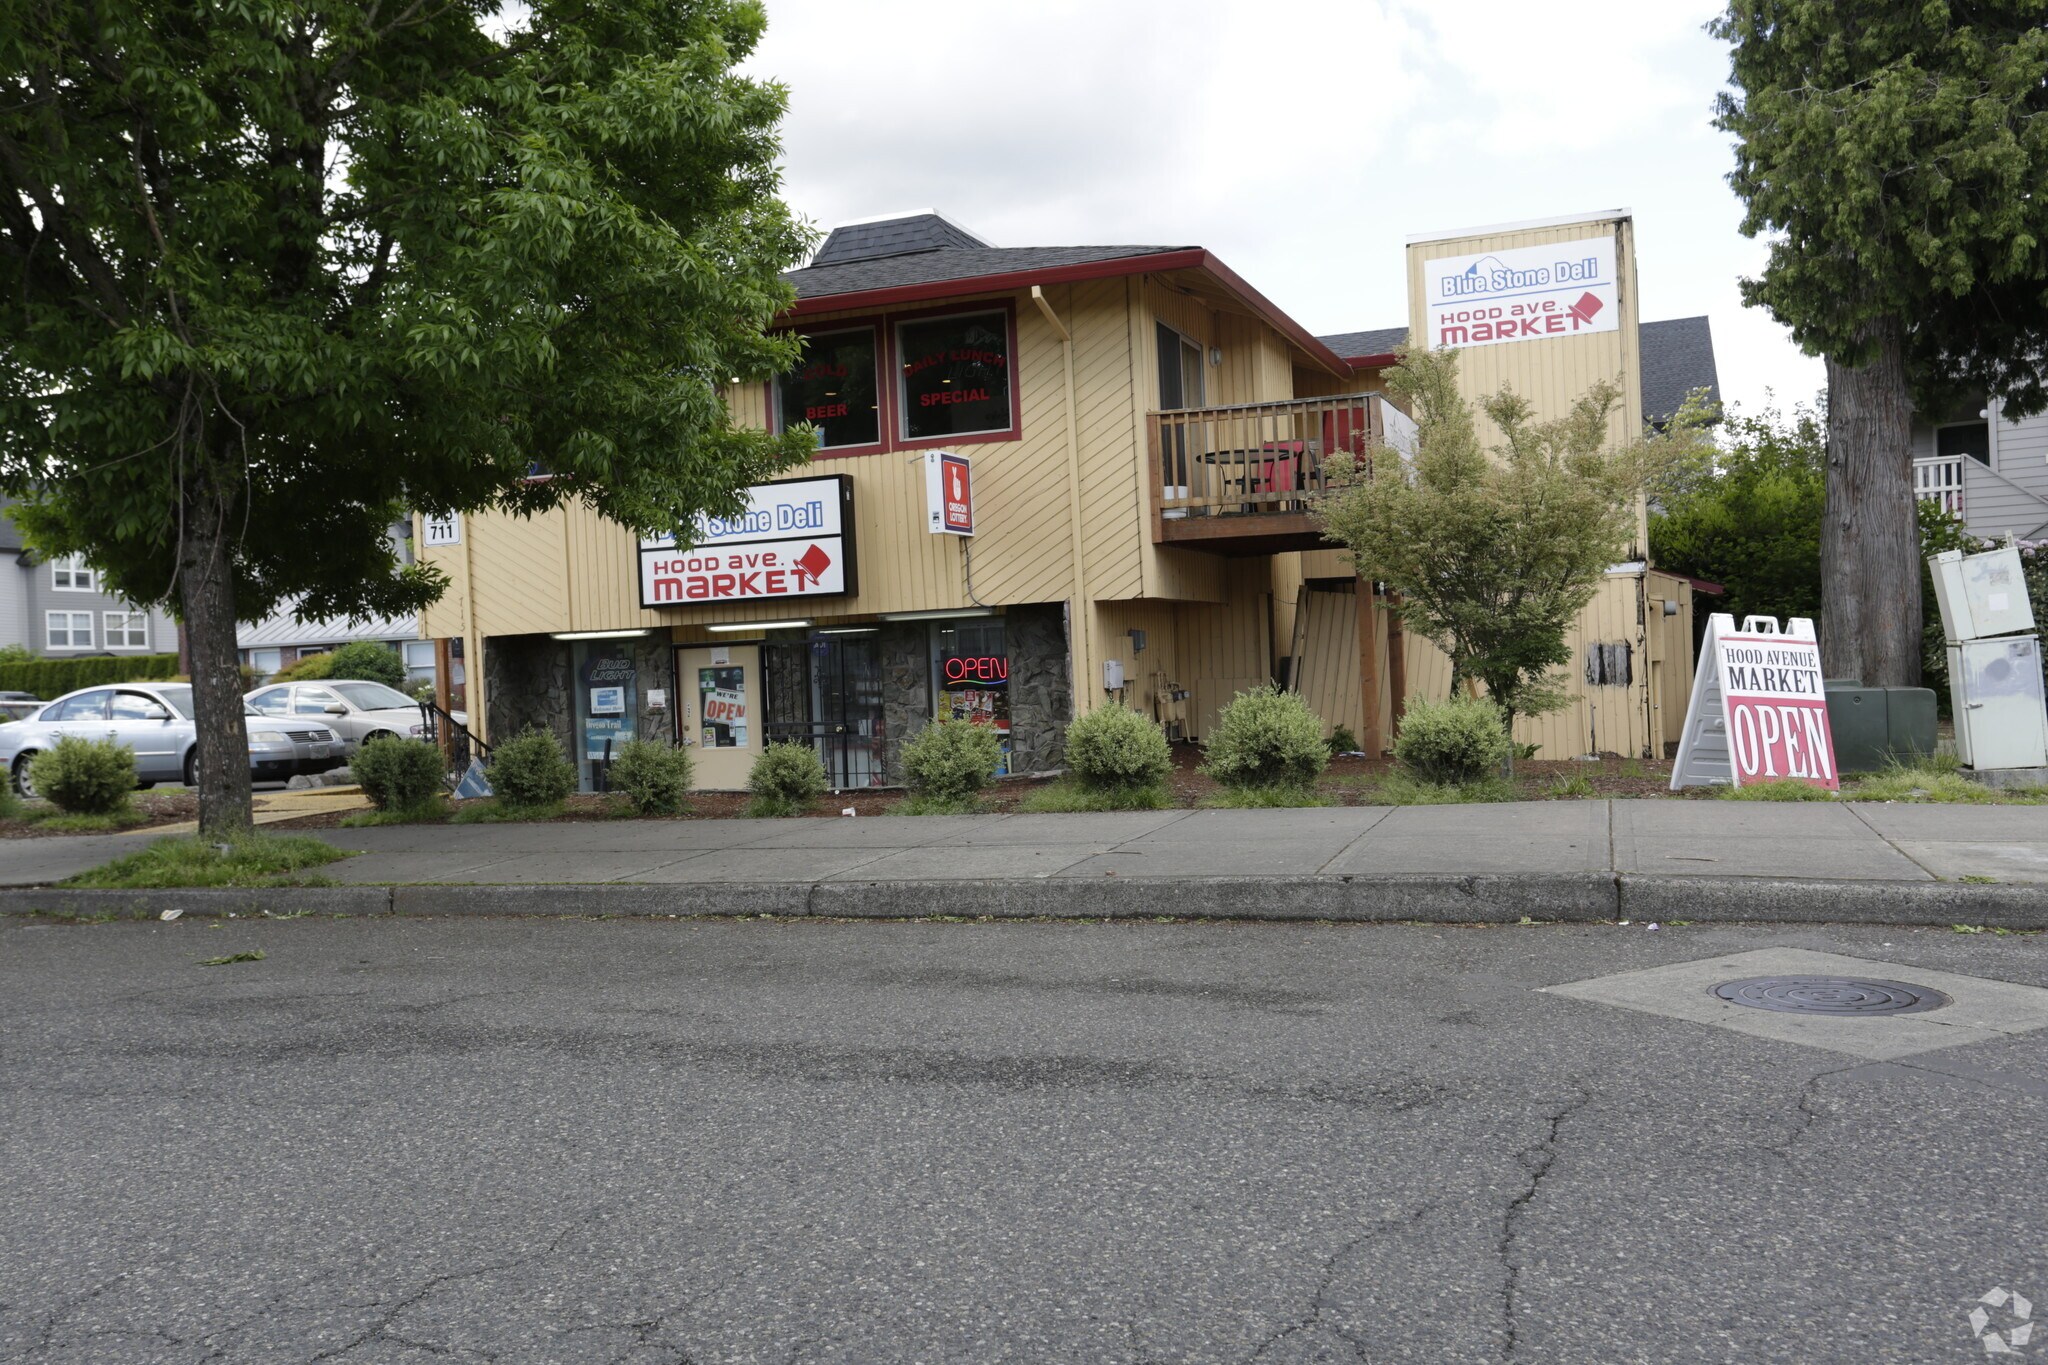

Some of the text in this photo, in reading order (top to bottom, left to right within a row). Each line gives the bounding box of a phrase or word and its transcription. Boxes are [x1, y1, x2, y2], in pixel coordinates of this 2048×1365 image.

[1441, 257, 1598, 297] Blue Stone Deli
[1441, 307, 1502, 325] HOOD
[804, 365, 848, 380] COLD
[903, 349, 1006, 378] DAILY LUNCH
[920, 388, 989, 407] SPECIAL
[806, 403, 848, 420] BEER
[710, 508, 771, 534] Stone
[776, 500, 823, 531] Deli
[949, 502, 968, 513] OREGON
[949, 511, 968, 523] LOTTERY
[430, 523, 453, 540] 711
[654, 556, 719, 575] HOOD
[598, 659, 631, 670] BUD
[1726, 648, 1816, 668] HOOD AVENUE
[590, 670, 635, 680] LIGHT
[945, 657, 1008, 679] OPEN
[1727, 666, 1819, 694] MARKET
[706, 699, 745, 721] OPEN
[607, 719, 622, 729] Trail
[1733, 703, 1832, 780] OPEN
